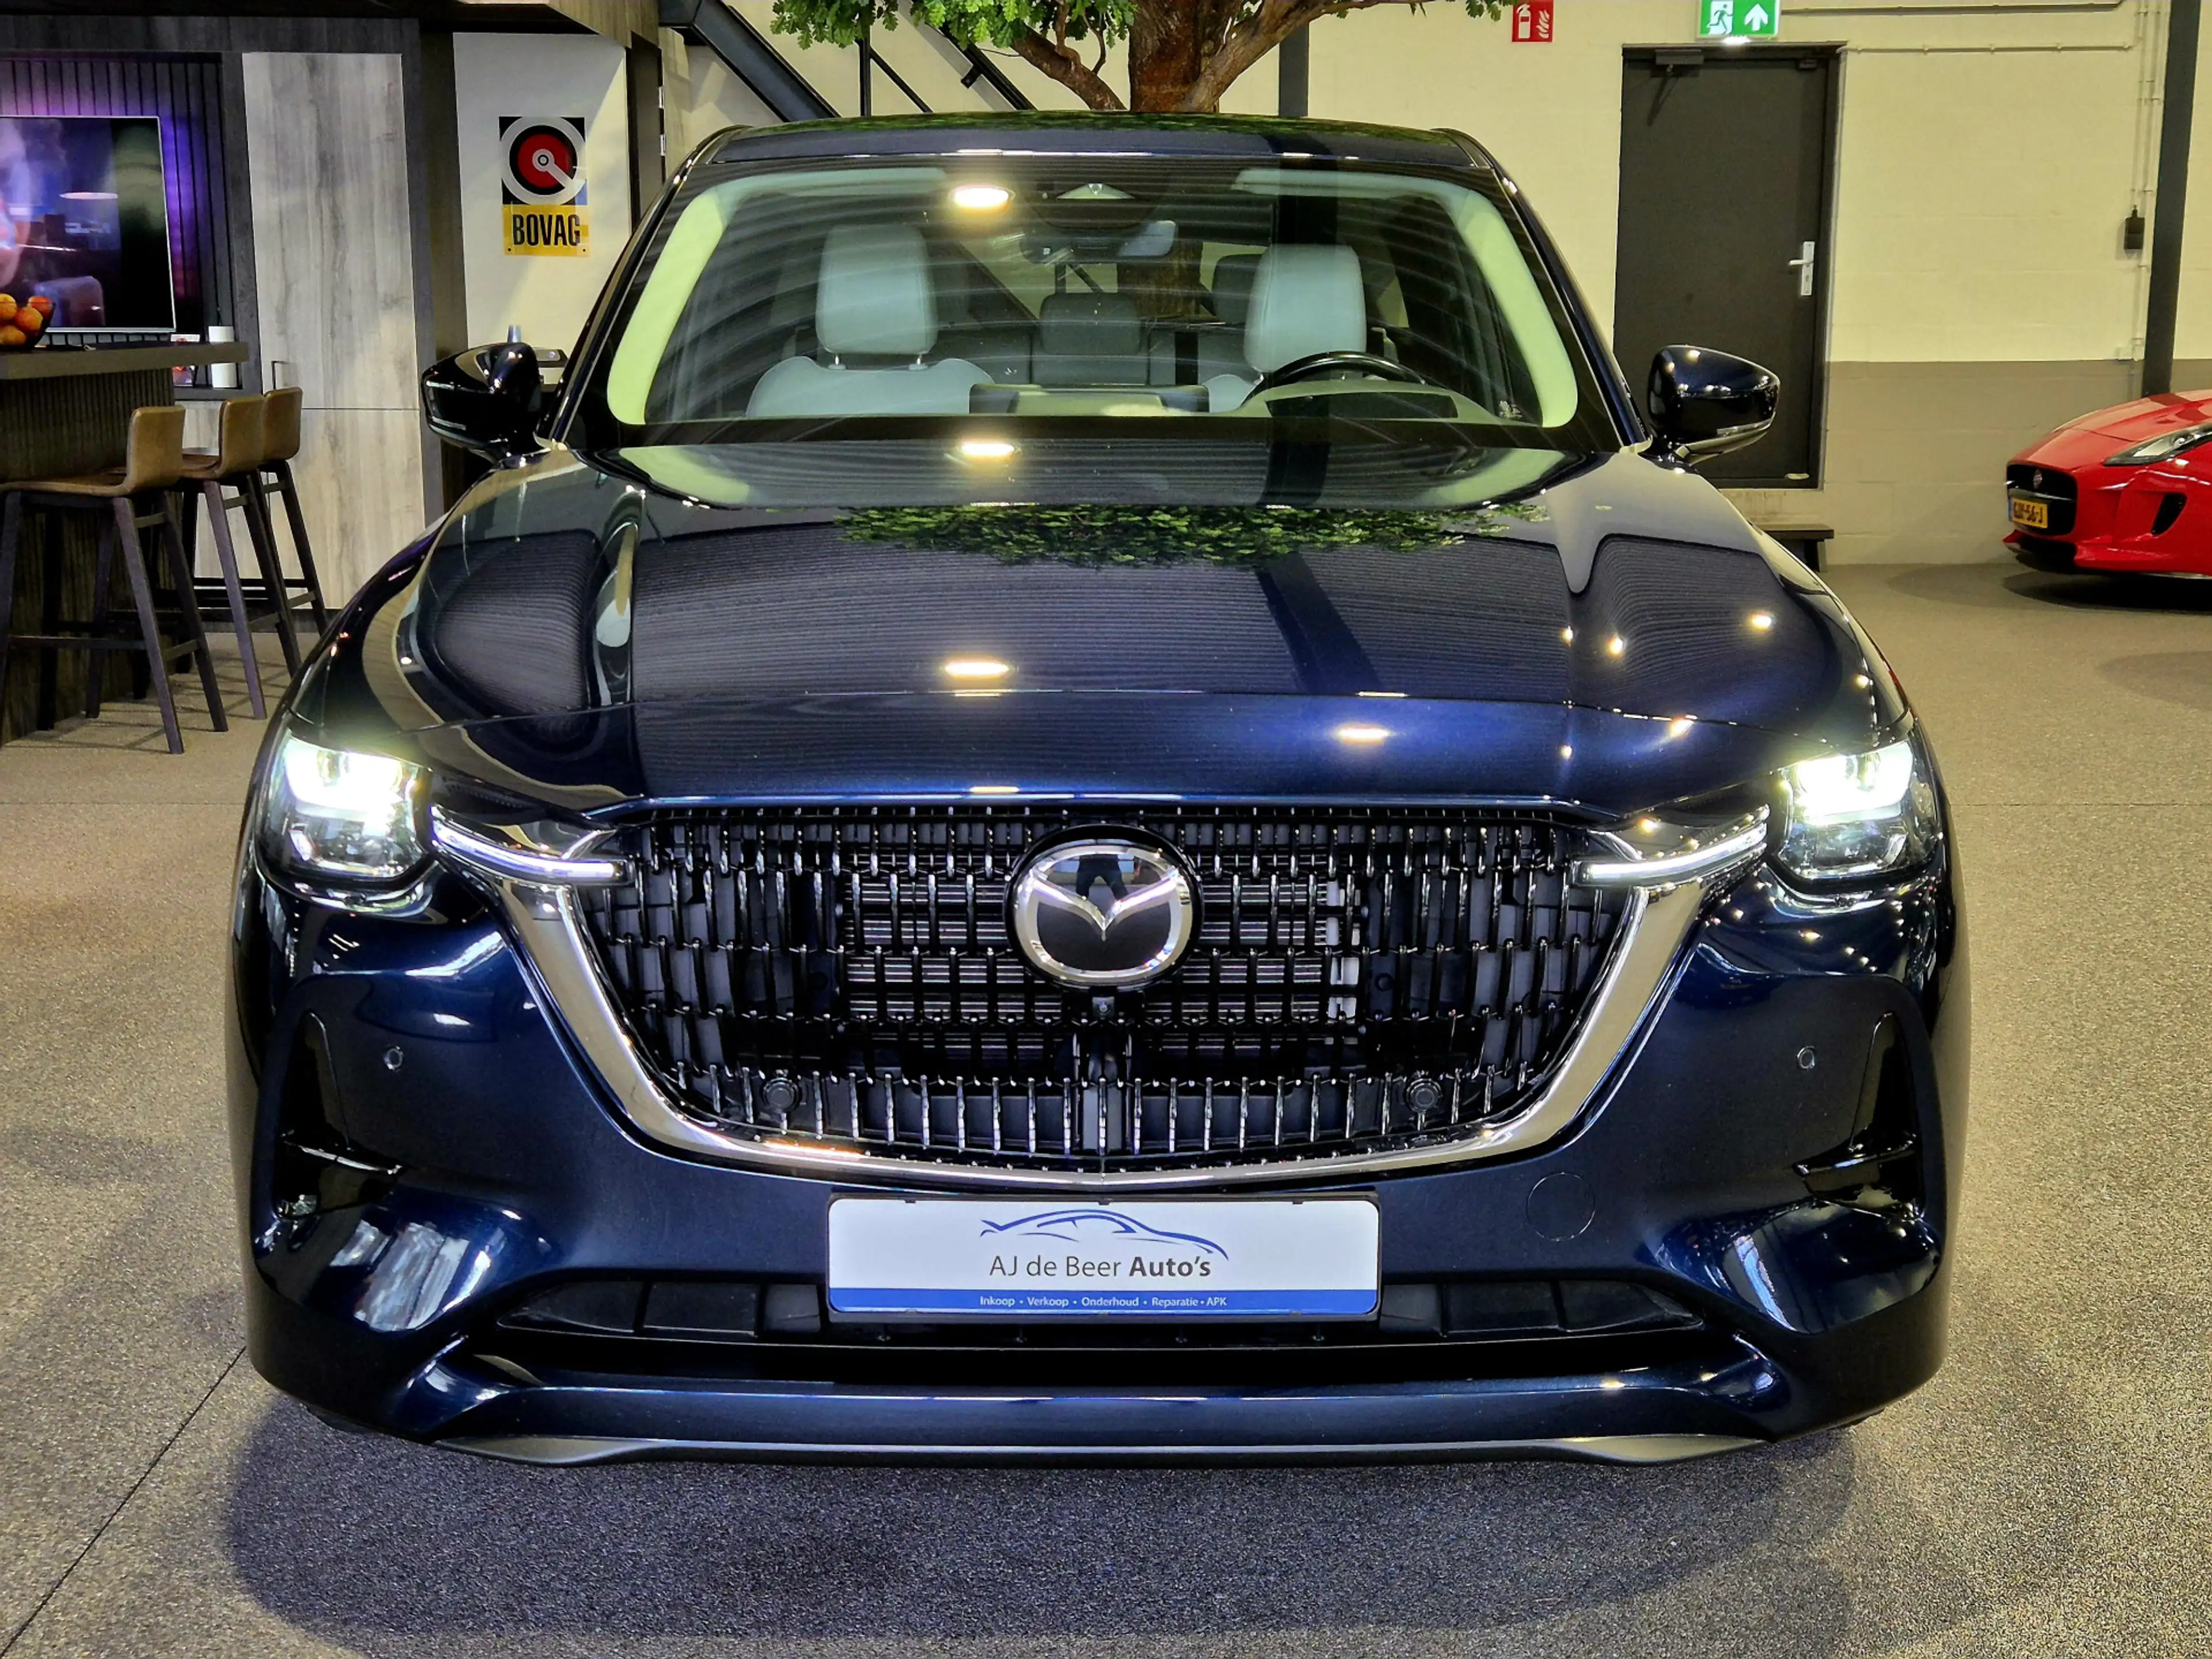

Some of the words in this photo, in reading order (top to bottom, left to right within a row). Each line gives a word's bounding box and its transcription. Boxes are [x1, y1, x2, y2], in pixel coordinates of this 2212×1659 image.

[513, 214, 581, 246] BOVAG
[989, 1255, 1018, 1276] AJ
[1027, 1255, 1057, 1277] de
[1066, 1256, 1121, 1277] Beer
[1129, 1256, 1211, 1277] Auto's
[979, 1296, 1016, 1307] Inkoop
[1027, 1296, 1069, 1308] Verkoop
[1081, 1297, 1139, 1307] Onderhoud
[1152, 1297, 1199, 1308] Reparatie
[1206, 1297, 1228, 1306] APK
